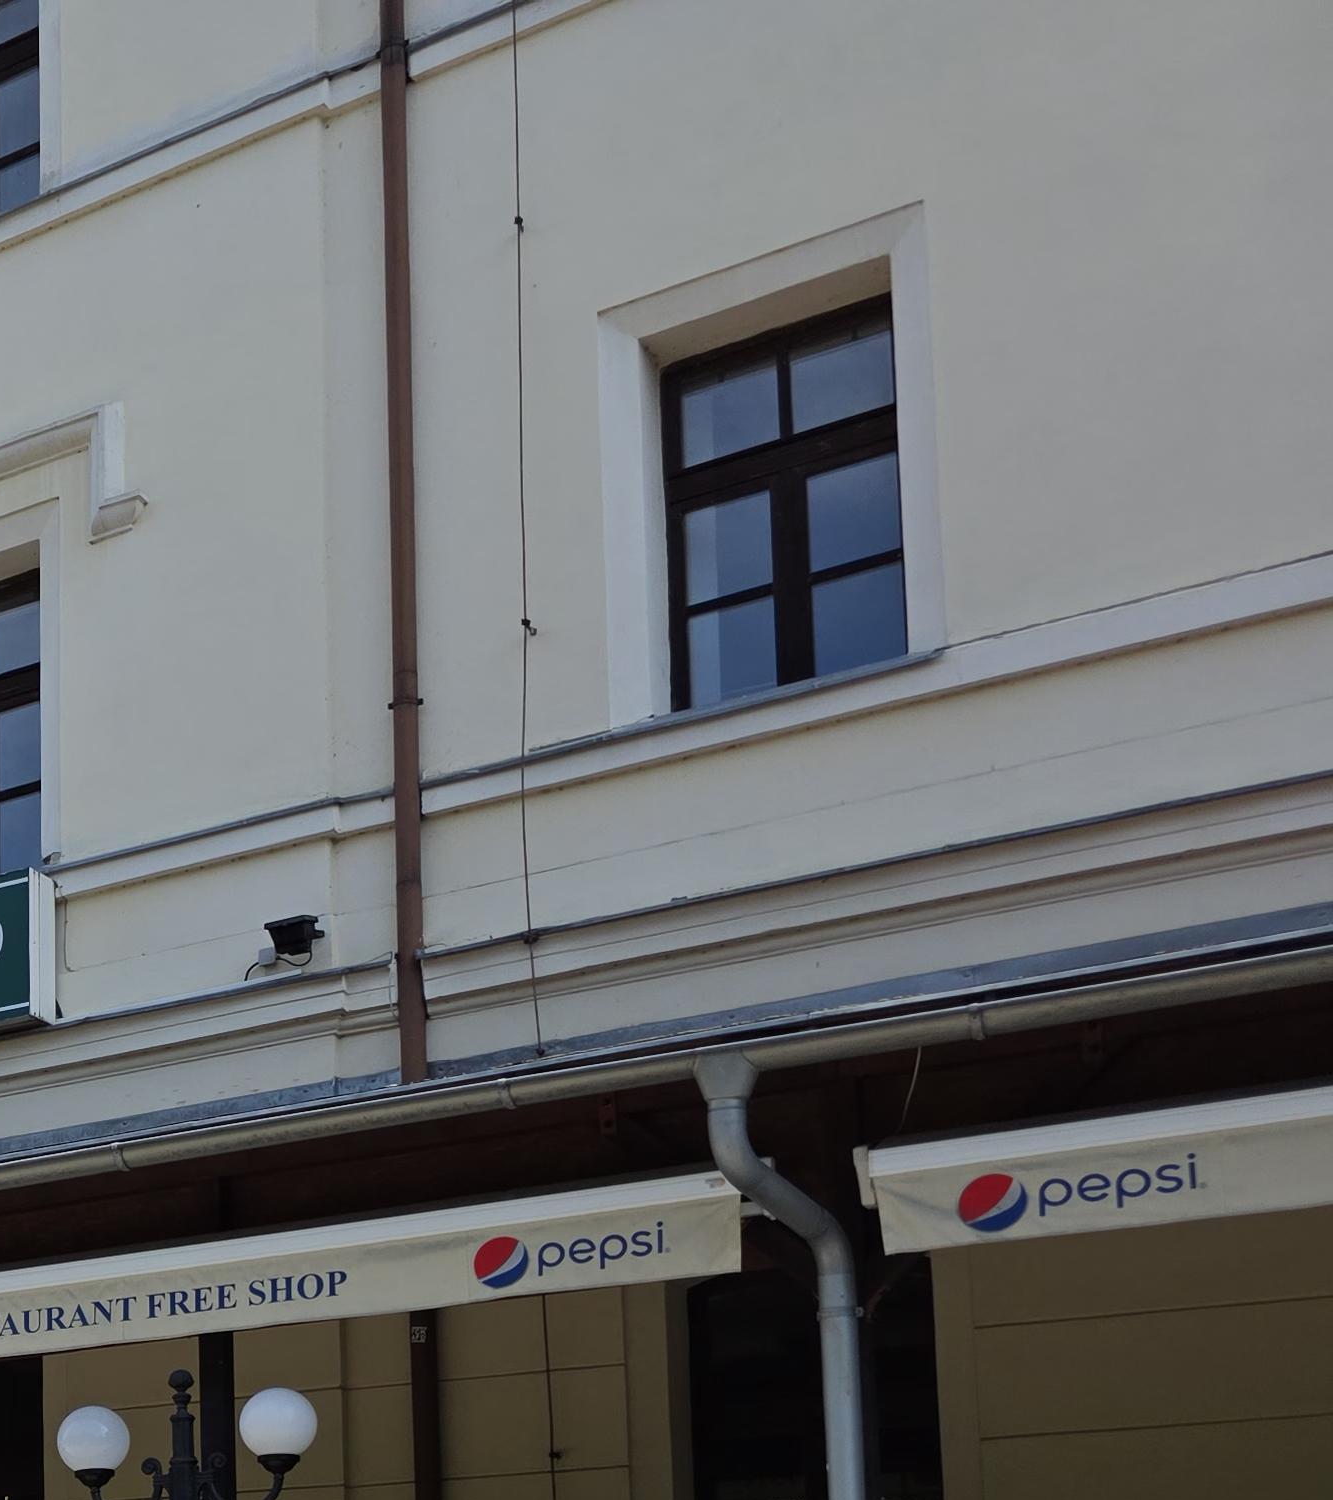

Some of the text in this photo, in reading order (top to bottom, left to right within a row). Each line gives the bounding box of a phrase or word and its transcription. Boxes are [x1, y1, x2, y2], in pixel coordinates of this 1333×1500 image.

[1038, 1153, 1198, 1217] pepsi
[147, 1283, 237, 1320] FREE
[248, 1270, 348, 1306] SHOP
[537, 1221, 664, 1277] pepsi
